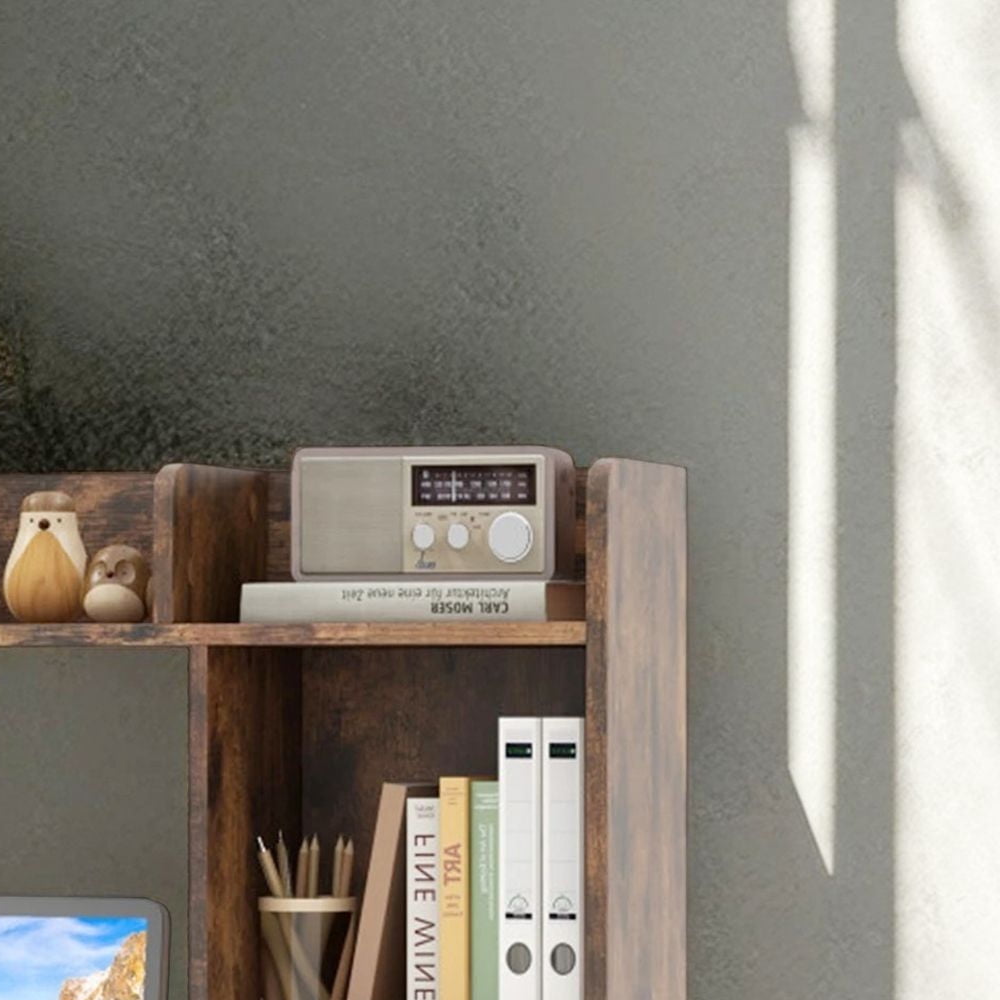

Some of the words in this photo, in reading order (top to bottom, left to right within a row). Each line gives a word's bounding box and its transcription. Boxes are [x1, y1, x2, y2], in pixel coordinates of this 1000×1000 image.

[341, 588, 365, 601] Zeit
[367, 587, 395, 599] neue
[397, 587, 422, 600] eine
[426, 587, 442, 601] für
[446, 587, 511, 600] Architektur
[430, 601, 473, 614] MOSER
[478, 601, 509, 614] CARL
